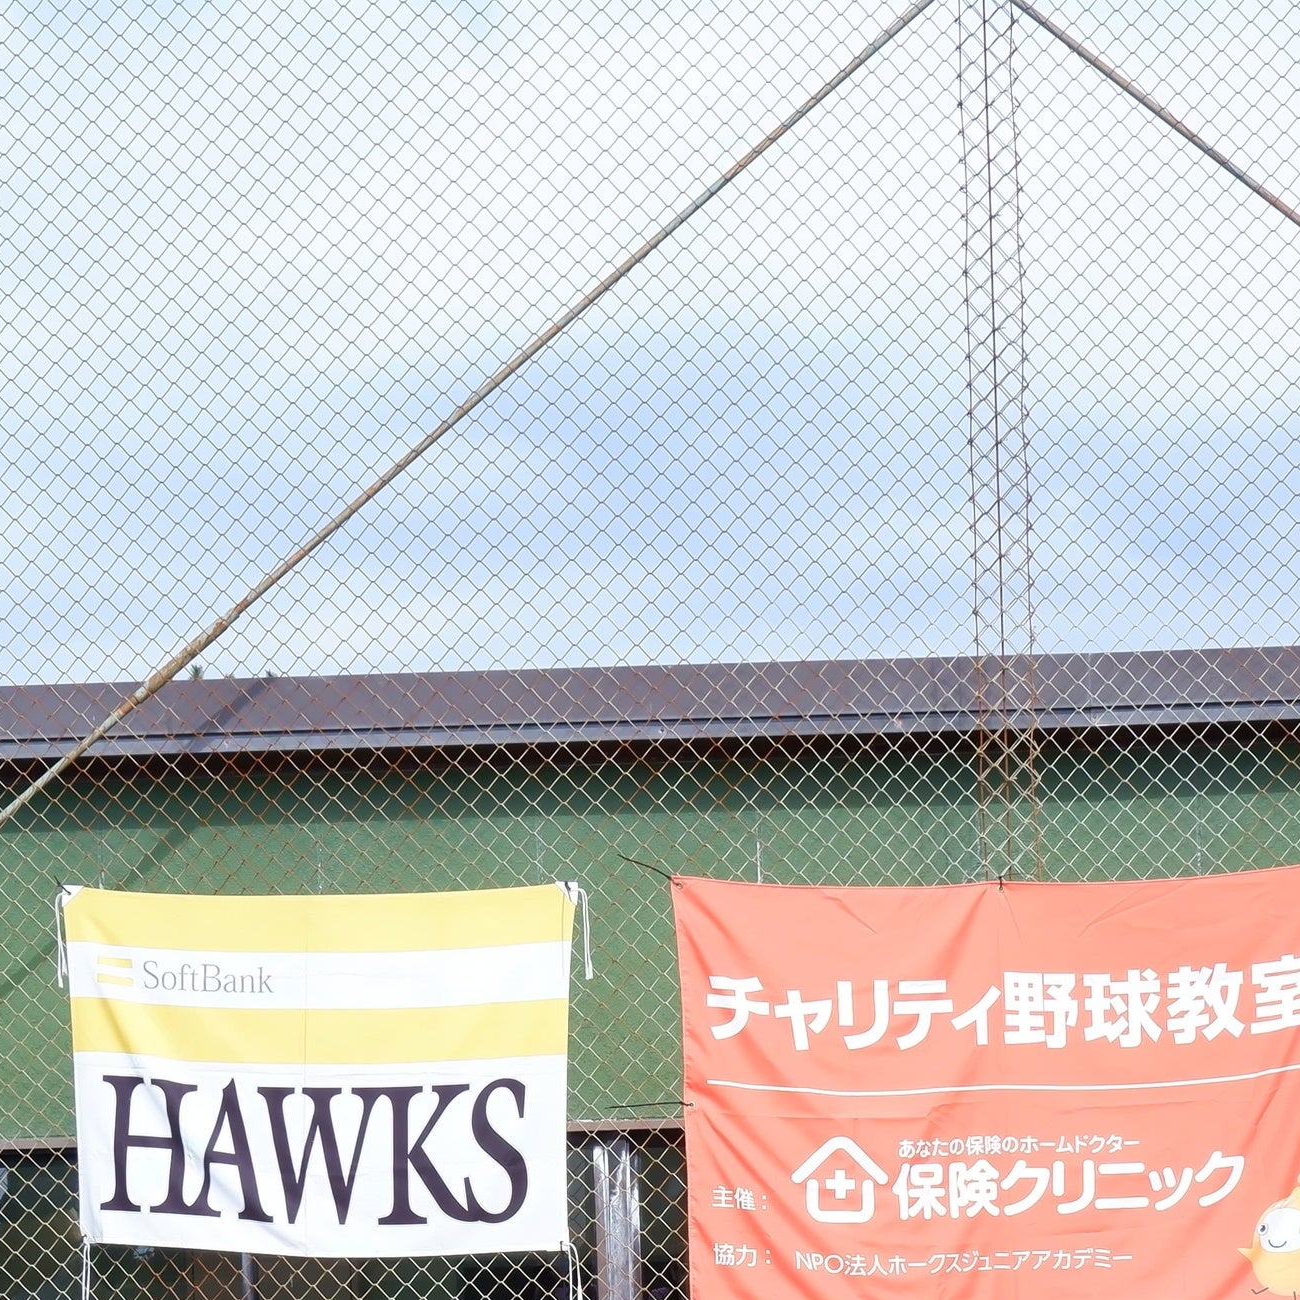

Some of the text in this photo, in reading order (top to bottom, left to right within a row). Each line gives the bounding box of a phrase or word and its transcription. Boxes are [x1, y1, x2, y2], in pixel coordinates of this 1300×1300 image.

[143, 960, 275, 994] SoftBank
[100, 1074, 530, 1227] HAWKS
[898, 1133, 1140, 1159] あなたの保険のホームドクター
[892, 1150, 1246, 1221] 保険クリニック
[795, 1248, 1133, 1277] NPO法人ホークスジュニアアカデミー
